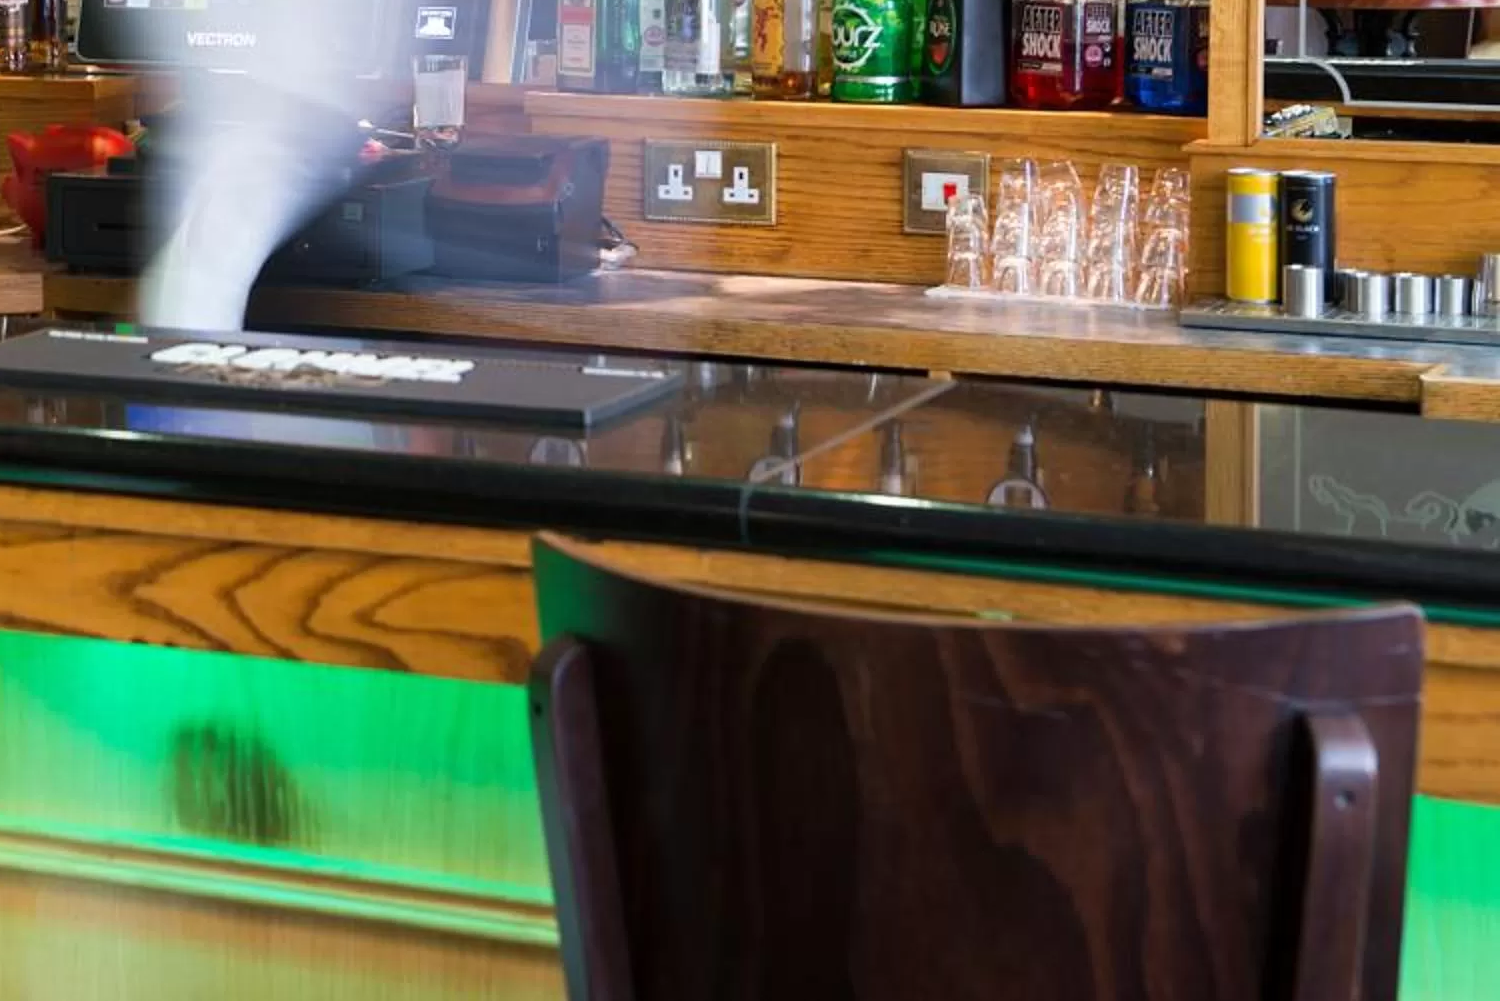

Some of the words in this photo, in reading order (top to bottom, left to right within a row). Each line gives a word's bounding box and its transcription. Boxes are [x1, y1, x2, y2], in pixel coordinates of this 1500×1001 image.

[1022, 5, 1061, 32] AFTER
[186, 29, 257, 49] VECTRON
[1022, 33, 1061, 59] SHOCK
[1133, 37, 1173, 63] SHOCK
